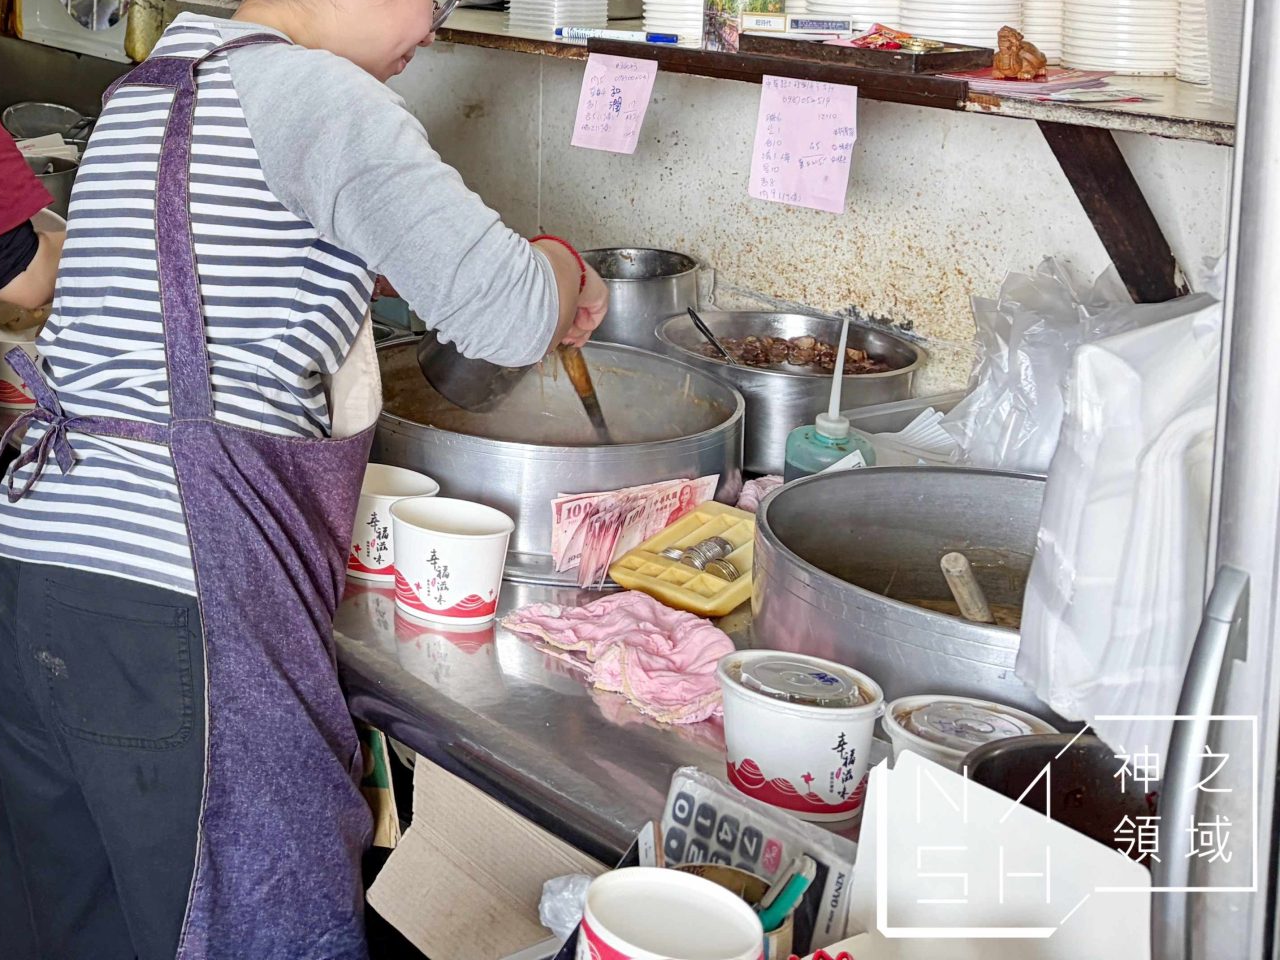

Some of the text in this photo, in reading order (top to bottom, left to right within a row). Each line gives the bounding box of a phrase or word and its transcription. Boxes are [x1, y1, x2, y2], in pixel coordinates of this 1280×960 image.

[366, 512, 389, 565] 幸福滋味
[565, 502, 593, 520] 100
[426, 548, 451, 605] 幸福滋味
[831, 731, 857, 800] 幸福滋味
